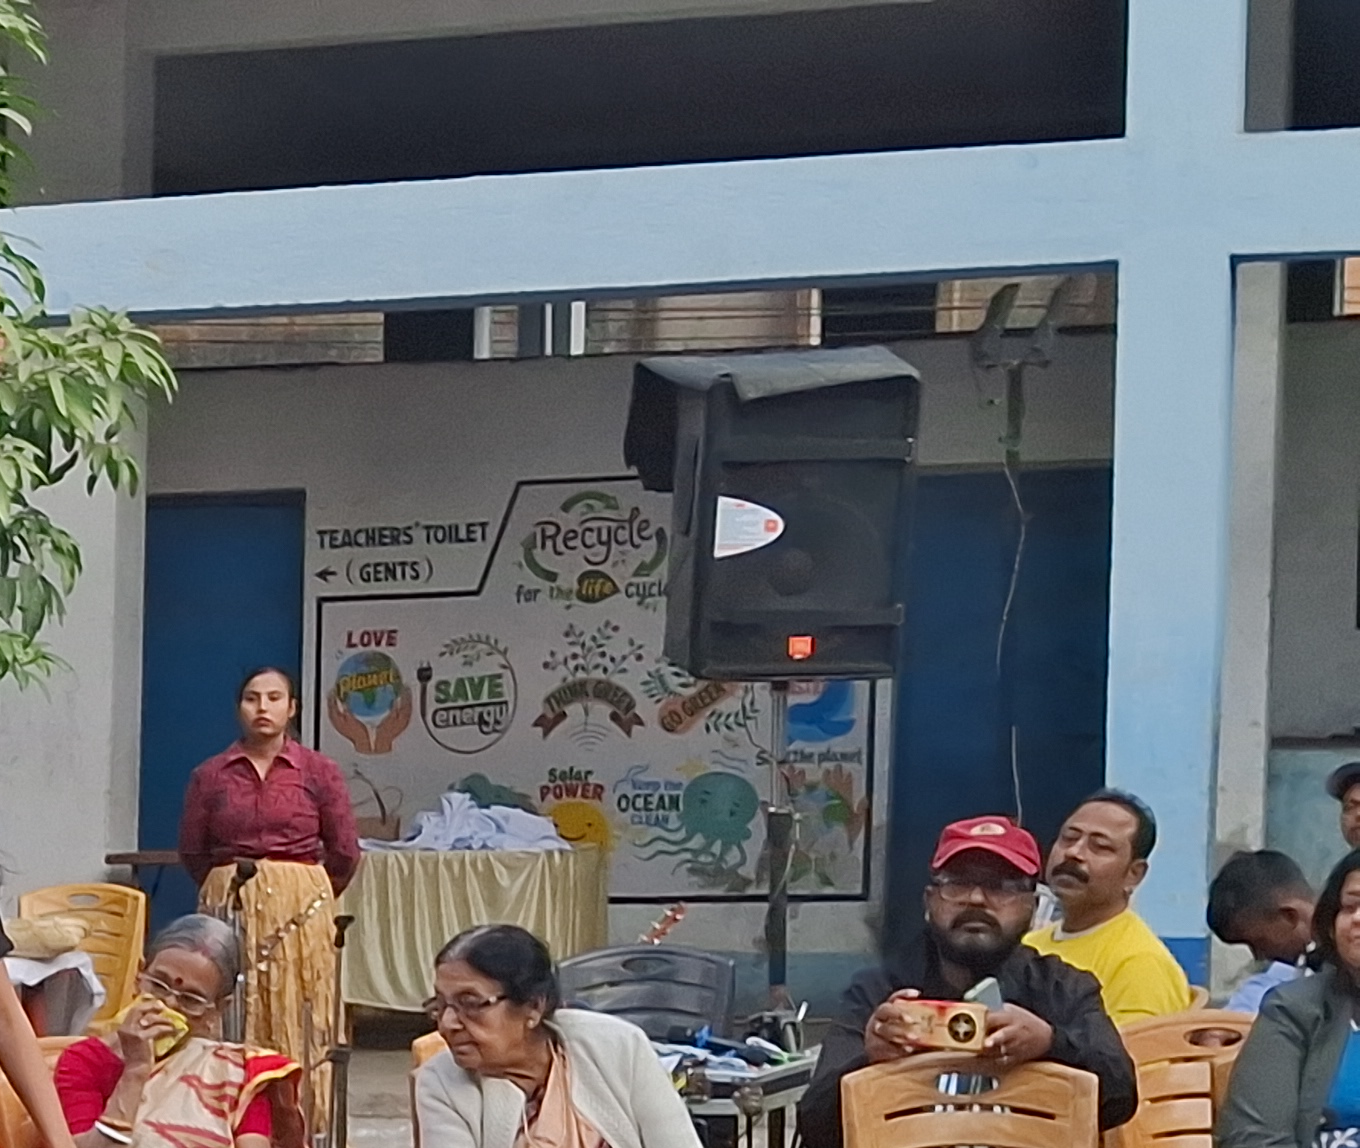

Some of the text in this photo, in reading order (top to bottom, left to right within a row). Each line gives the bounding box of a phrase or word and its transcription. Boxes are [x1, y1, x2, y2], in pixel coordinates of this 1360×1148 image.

[423, 521, 489, 544] TOILET
[534, 506, 653, 566] Recycle
[515, 584, 541, 604] for
[625, 579, 664, 606] cycl
[346, 630, 399, 649] LOVE
[434, 674, 504, 705] SAVE
[435, 705, 506, 733] energy
[548, 766, 594, 783] Solar
[539, 782, 605, 803] POWER
[617, 792, 681, 813] OCEAN
